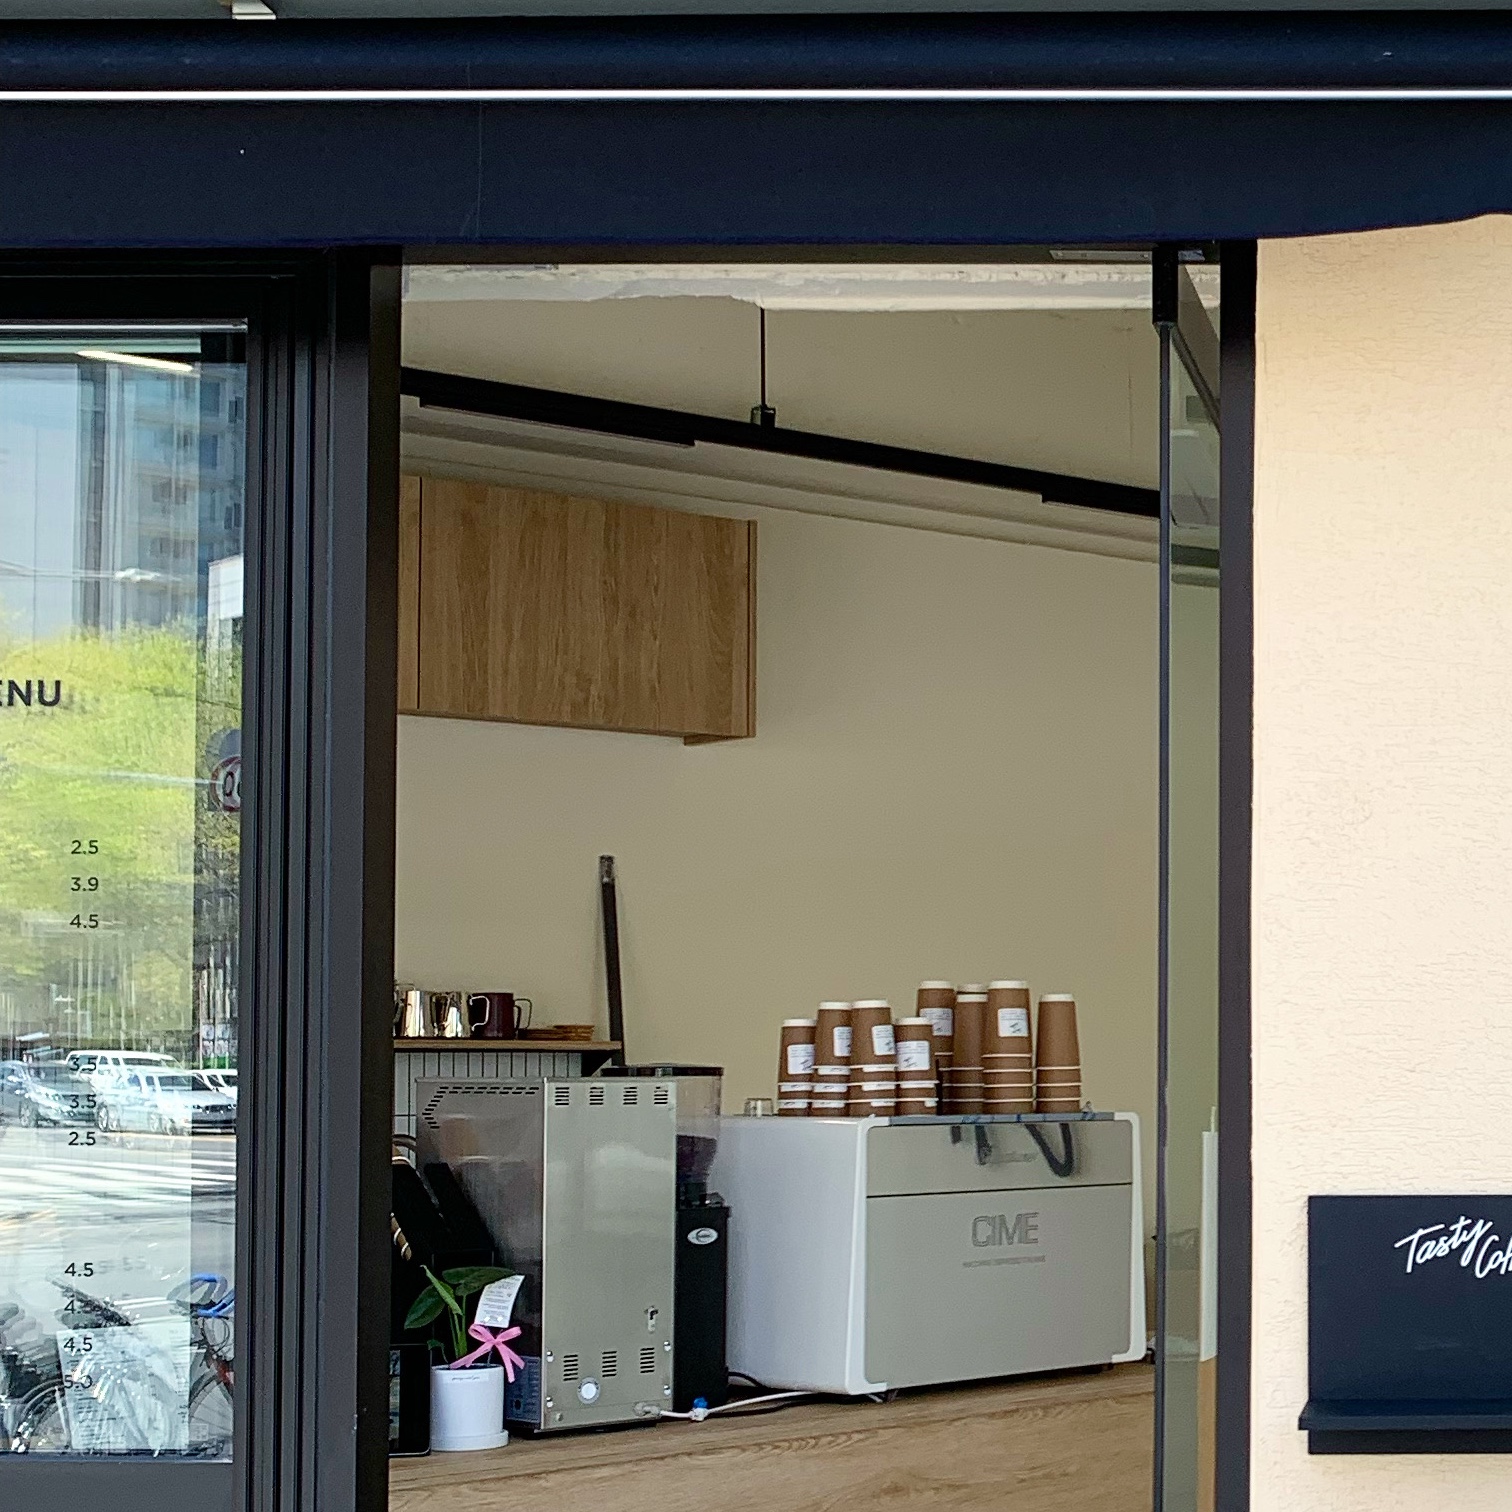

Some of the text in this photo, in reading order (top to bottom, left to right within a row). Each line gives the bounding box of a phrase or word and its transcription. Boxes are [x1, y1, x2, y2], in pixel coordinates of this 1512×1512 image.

[0, 679, 61, 707] NU
[71, 839, 99, 855] 2.5
[71, 876, 99, 892] 3.9
[69, 913, 99, 929] 4.5
[69, 1056, 97, 1072] 3.5
[69, 1093, 97, 1109] 3.5
[68, 1131, 97, 1146] 2.5
[971, 1211, 1041, 1248] CIME
[1393, 1215, 1494, 1273] Tasty
[64, 1262, 94, 1278] 4.5
[63, 1337, 93, 1353] 4.5
